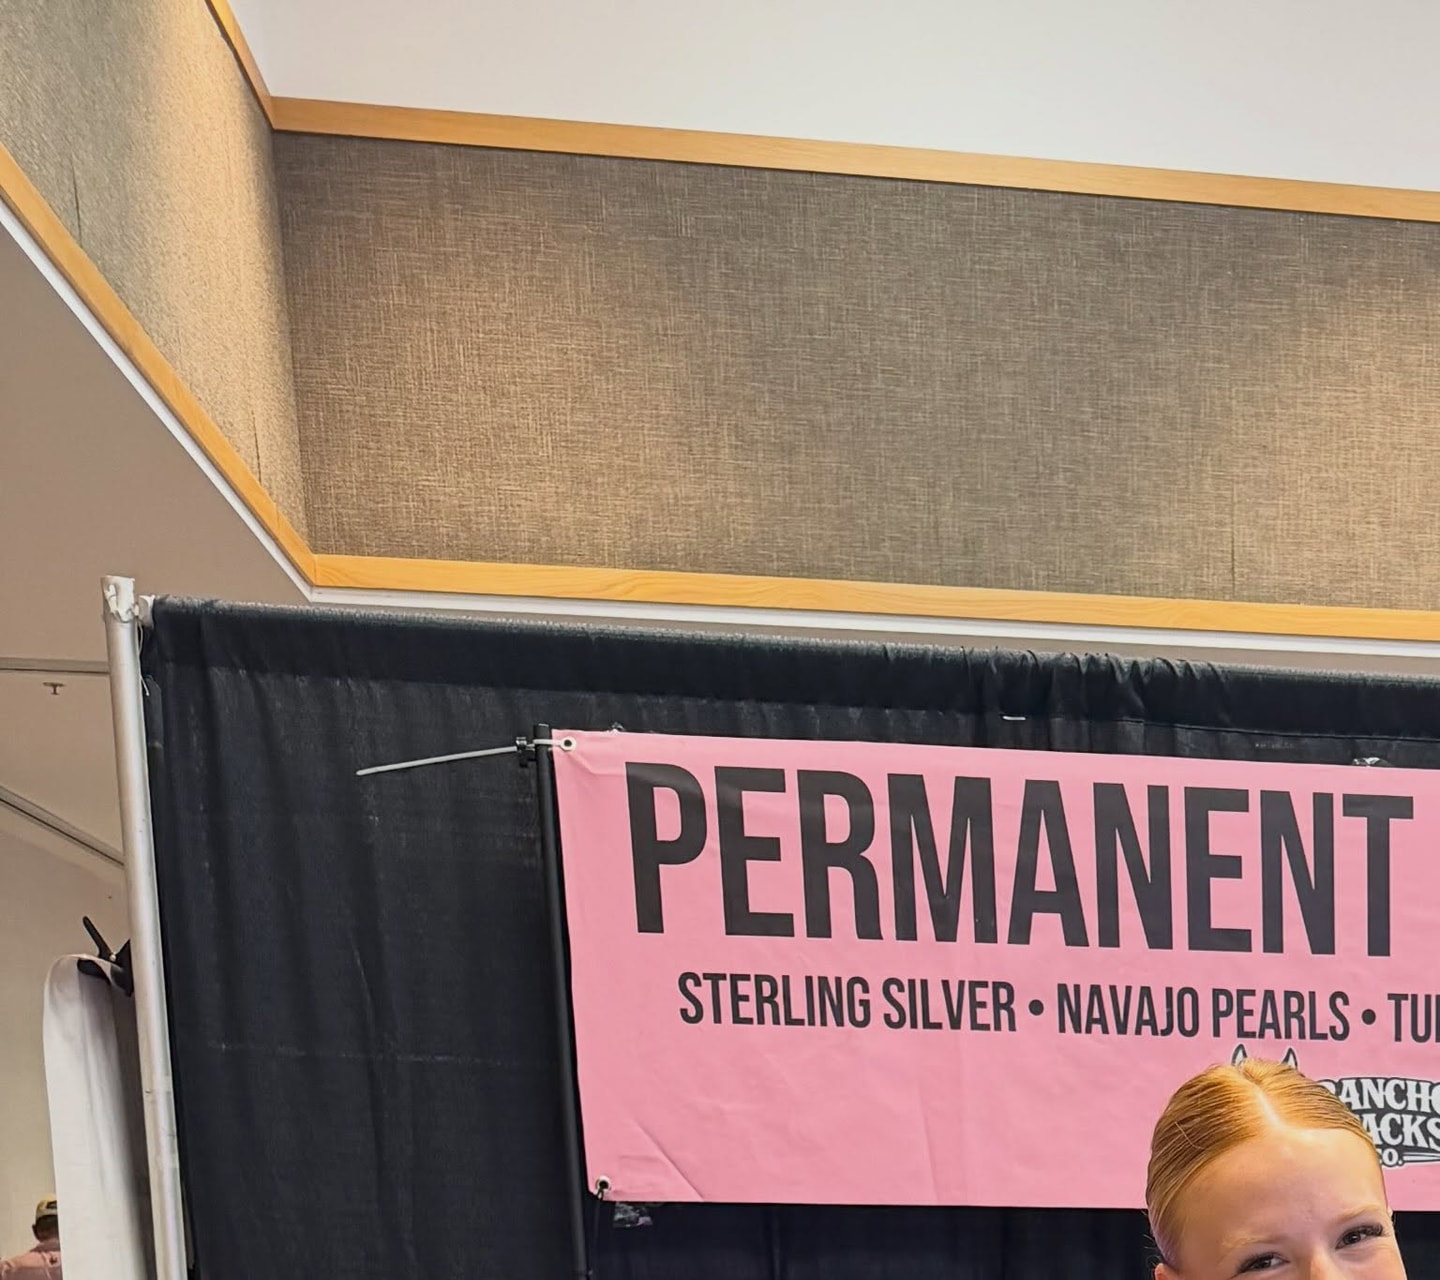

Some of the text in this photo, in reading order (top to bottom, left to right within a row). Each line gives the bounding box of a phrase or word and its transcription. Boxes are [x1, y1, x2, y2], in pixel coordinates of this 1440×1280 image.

[625, 761, 1414, 957] PERMANENT
[678, 971, 871, 1029] STERLING
[882, 977, 1017, 1032] SILVER
[1057, 983, 1200, 1038] NAVAJO
[1211, 987, 1350, 1041] PEARLS
